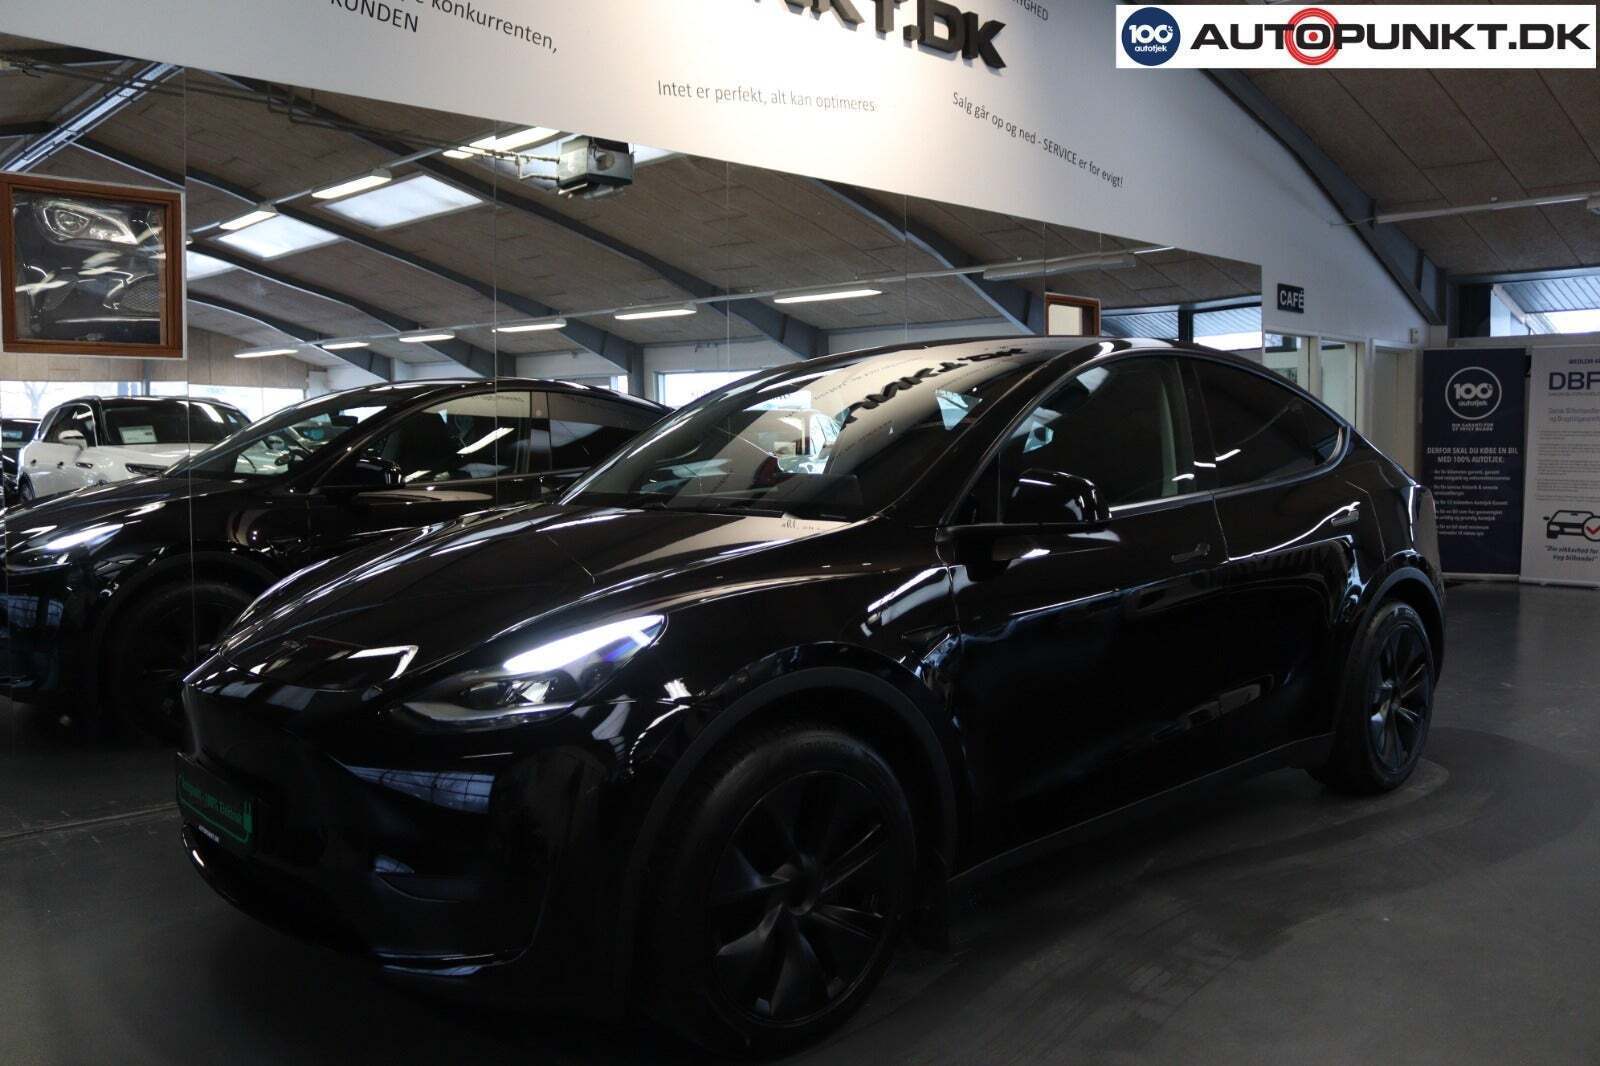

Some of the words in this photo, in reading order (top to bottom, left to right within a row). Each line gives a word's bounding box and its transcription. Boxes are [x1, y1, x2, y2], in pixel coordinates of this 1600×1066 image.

[657, 80, 691, 98] Intet
[696, 84, 710, 99] er
[715, 86, 767, 105] perfekt,
[770, 89, 786, 105] alt
[790, 91, 812, 107] kan
[952, 91, 972, 115] Salg
[974, 104, 990, 119] går
[992, 114, 1004, 129] op
[1005, 122, 1017, 137] og
[1019, 127, 1036, 145] ned
[1043, 137, 1077, 166] SERVICE
[1078, 159, 1087, 169] er
[1089, 160, 1100, 177] for
[1102, 170, 1123, 188] evigt!
